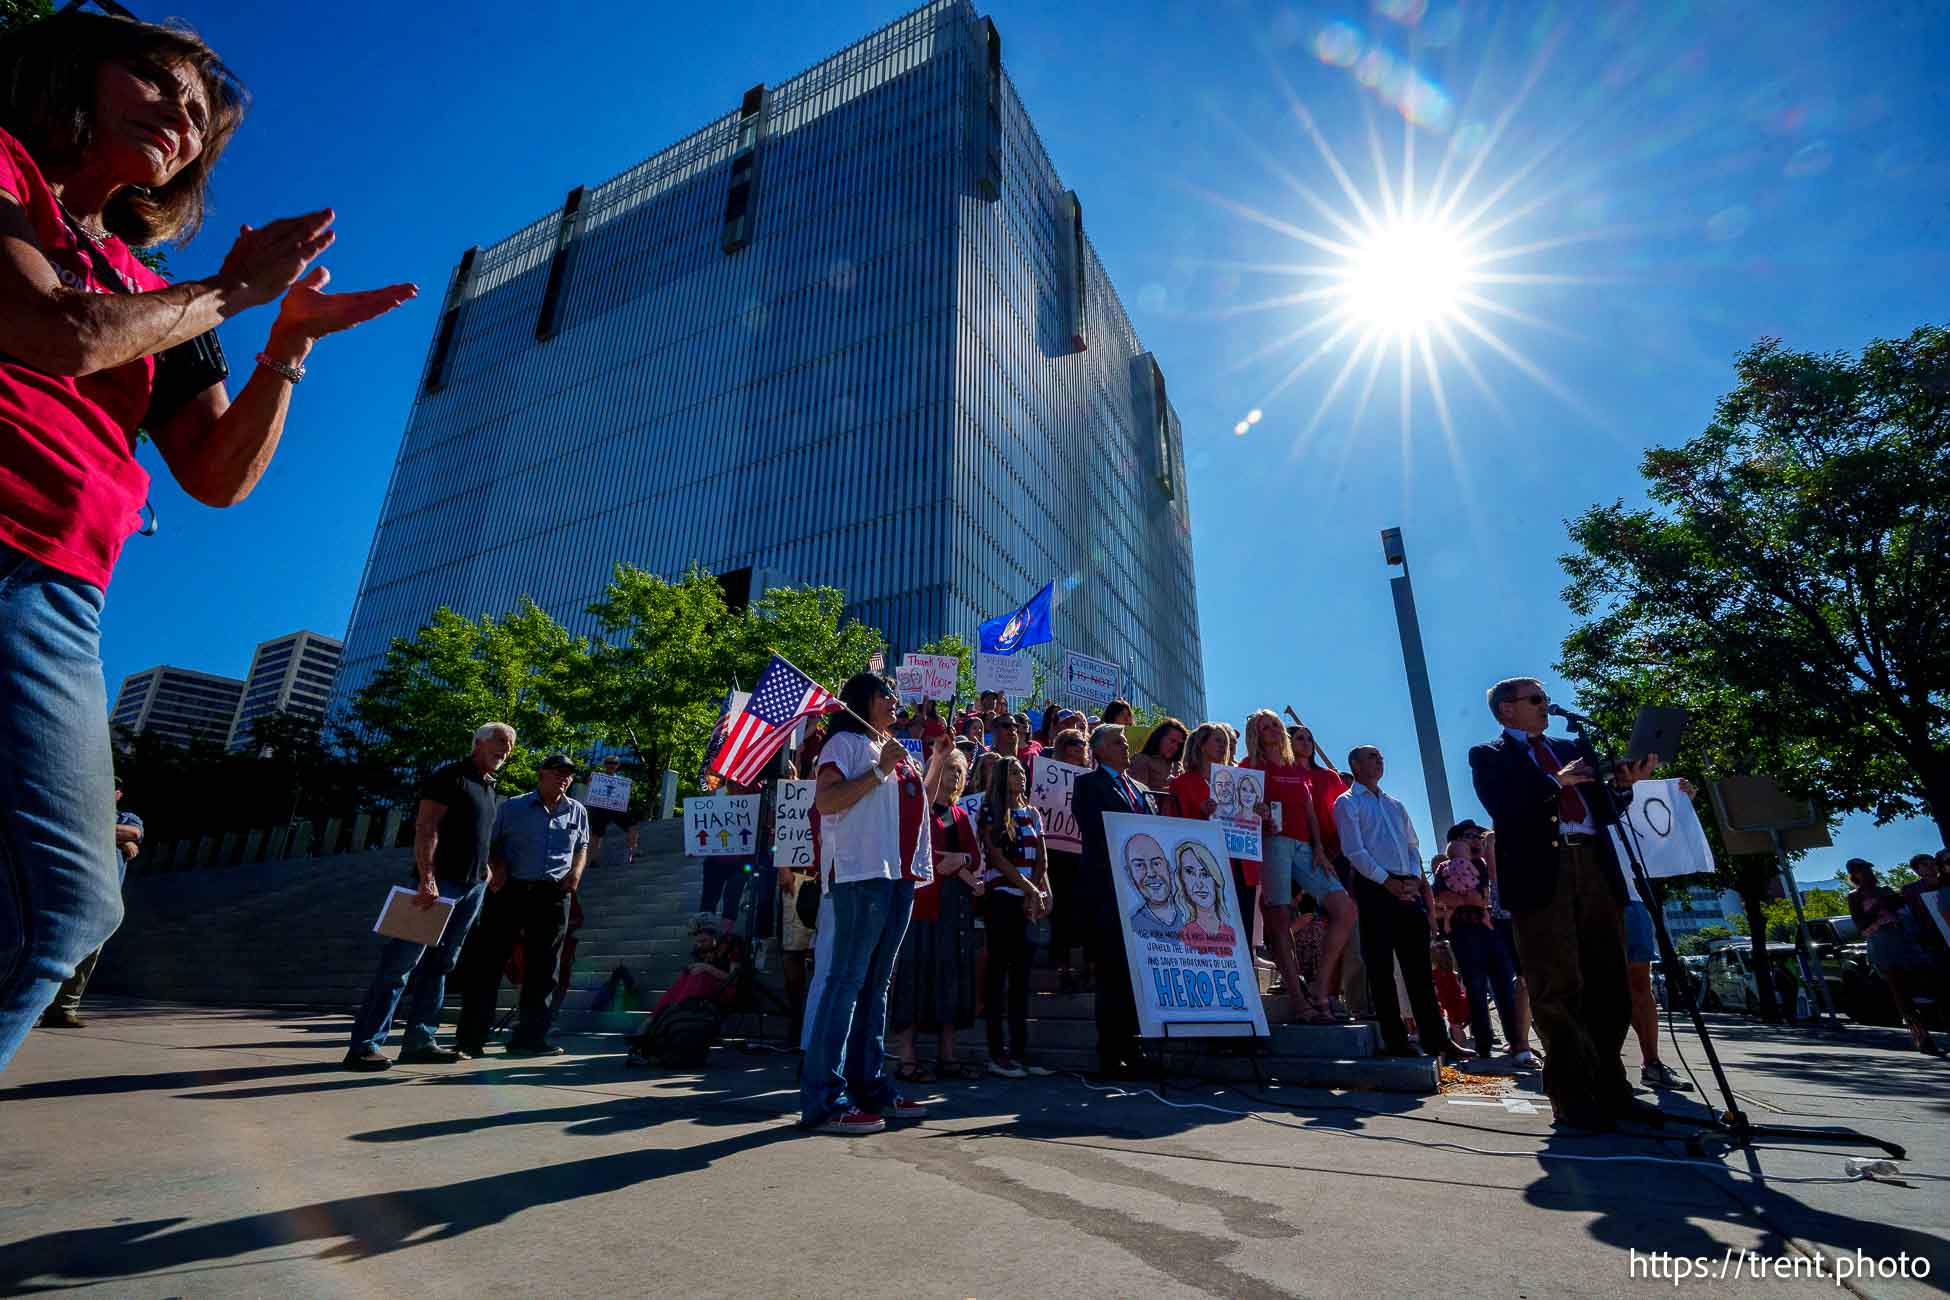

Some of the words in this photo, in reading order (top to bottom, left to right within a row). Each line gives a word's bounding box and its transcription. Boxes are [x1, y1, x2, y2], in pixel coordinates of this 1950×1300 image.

[907, 655, 933, 667] Thank
[694, 799, 714, 810] DO
[729, 799, 749, 809] NO
[694, 811, 751, 829] HARM
[1039, 807, 1081, 838] MOO
[777, 825, 814, 841] Give
[791, 846, 811, 865] To
[1171, 944, 1183, 954] THE
[1147, 956, 1159, 968] AND
[1152, 968, 1244, 1008] HEROES
